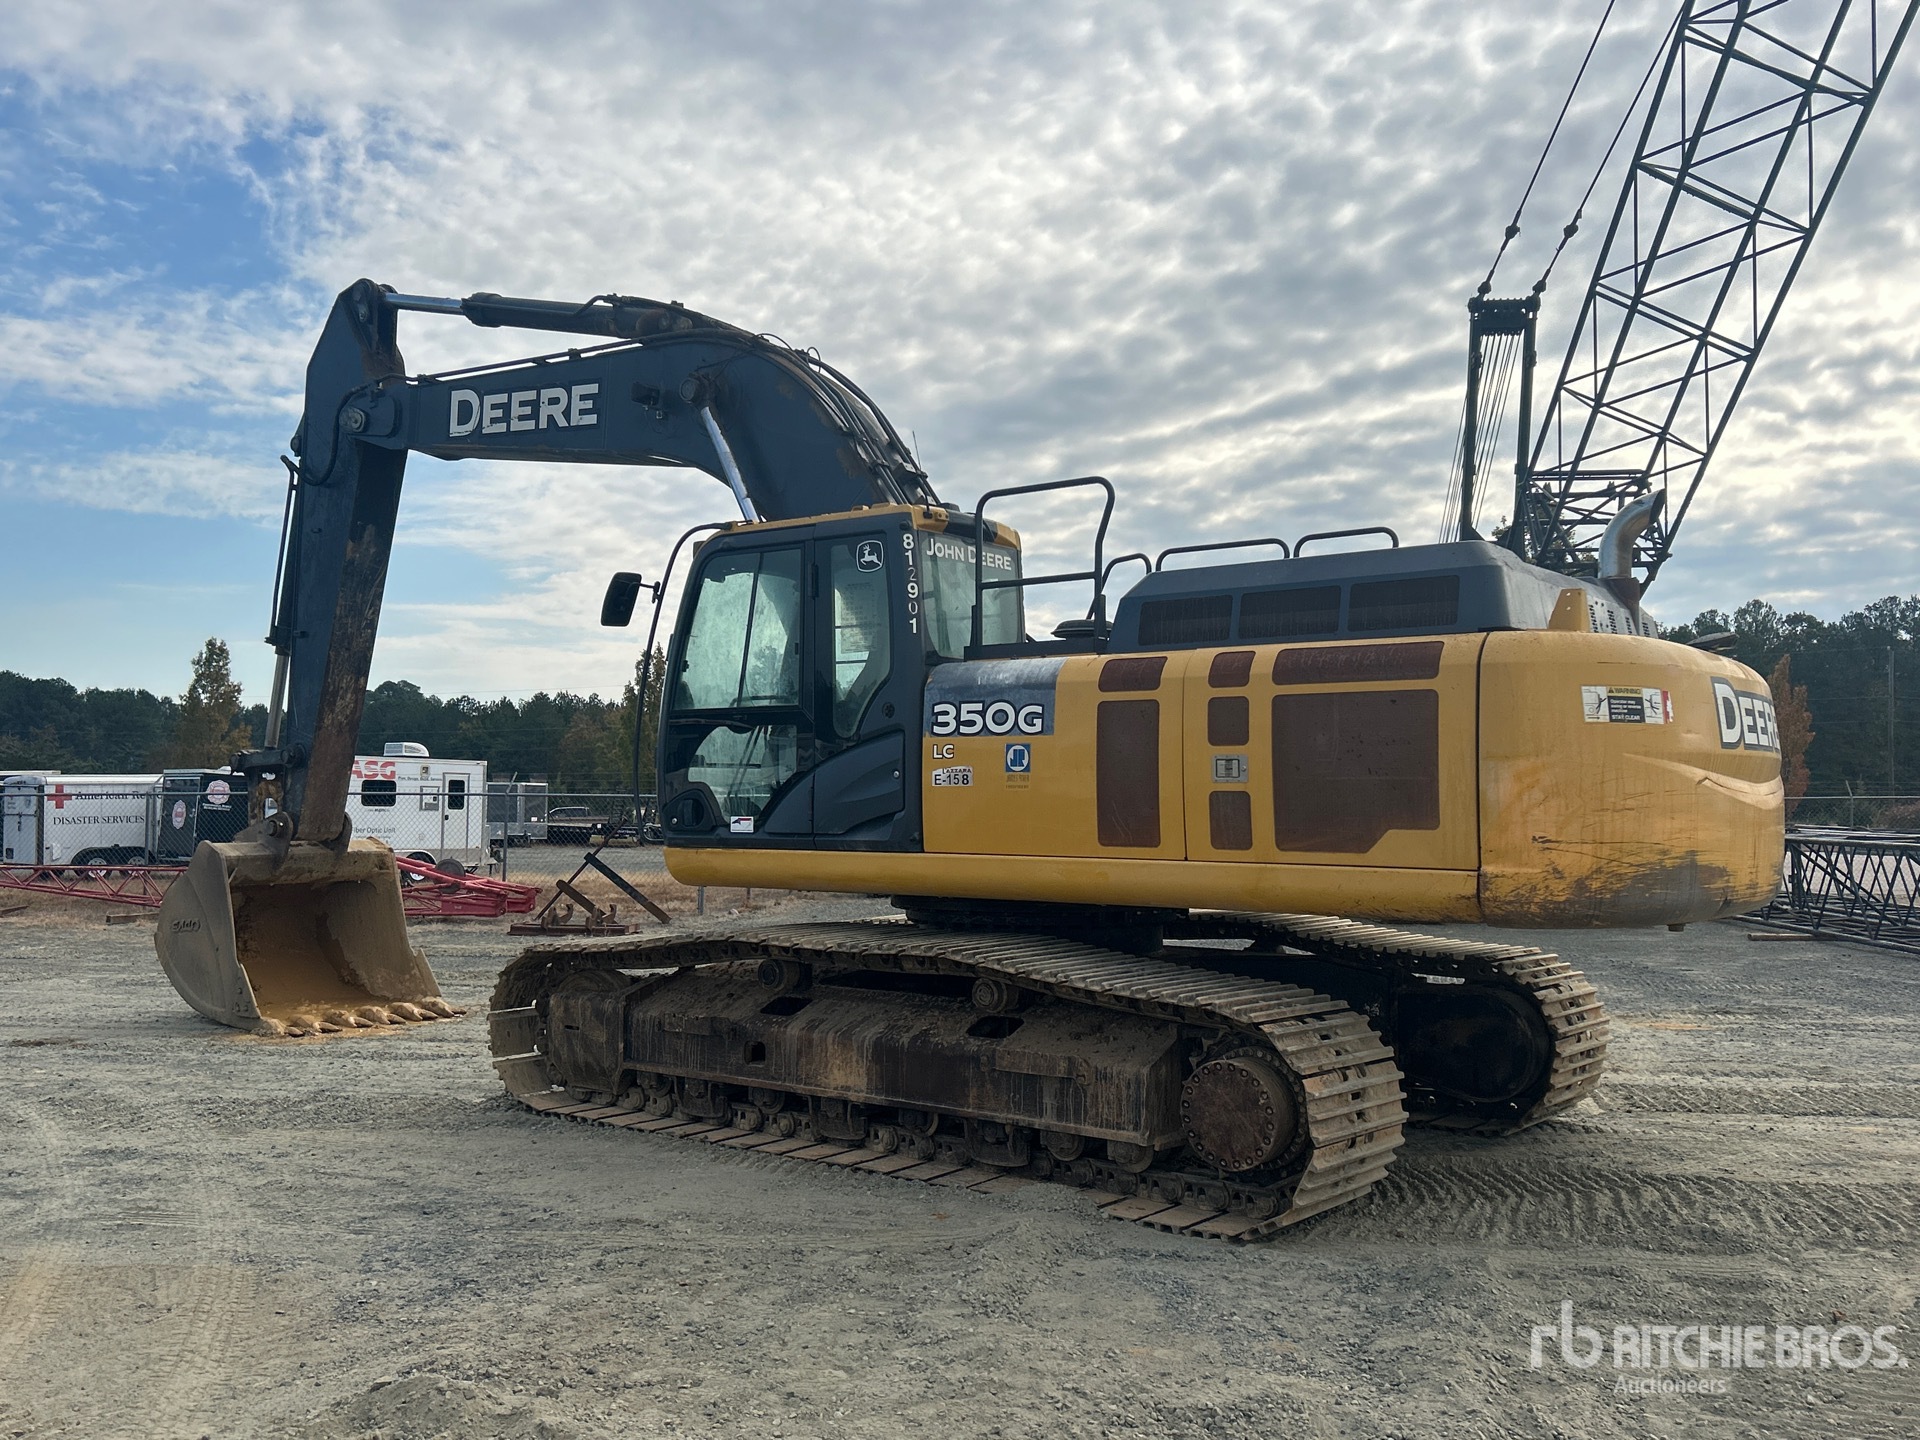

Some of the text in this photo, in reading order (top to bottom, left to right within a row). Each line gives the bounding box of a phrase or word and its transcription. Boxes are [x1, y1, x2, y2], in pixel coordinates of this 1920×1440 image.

[449, 383, 599, 437] DEERE
[926, 538, 965, 562] JOHN
[903, 533, 919, 634] 812901
[932, 701, 1043, 735] 350G
[933, 744, 954, 759] LC
[53, 815, 145, 825] DISASTER SERVICES
